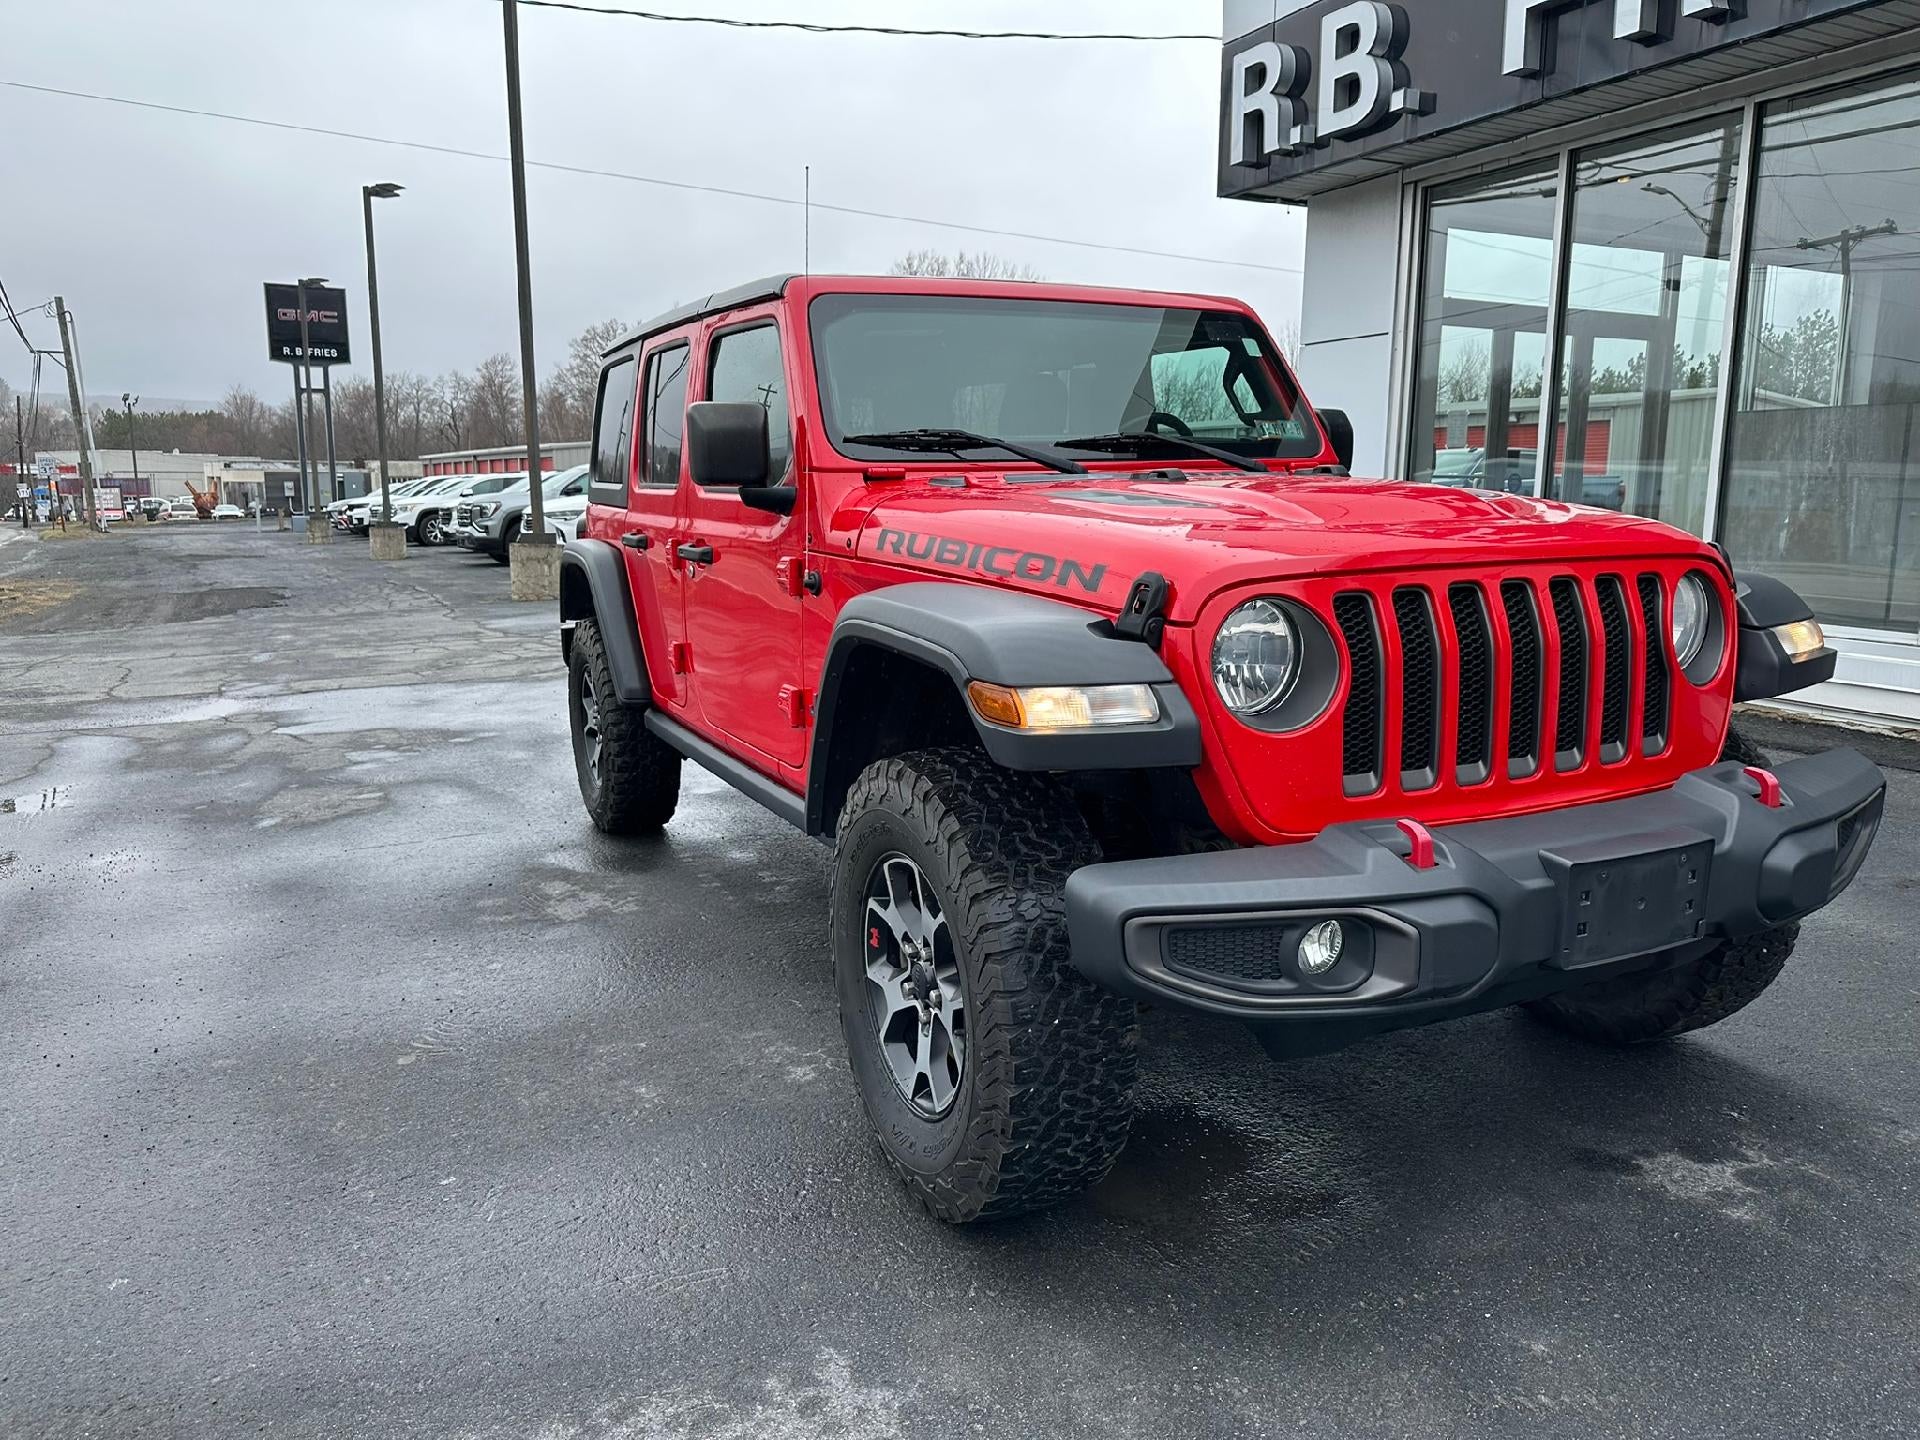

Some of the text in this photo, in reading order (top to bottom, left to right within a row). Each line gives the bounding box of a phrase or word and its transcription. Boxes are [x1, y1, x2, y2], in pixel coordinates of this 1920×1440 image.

[277, 308, 338, 323] GMC
[283, 346, 338, 357] R. B FRIES
[876, 528, 1108, 592] RUBICON
